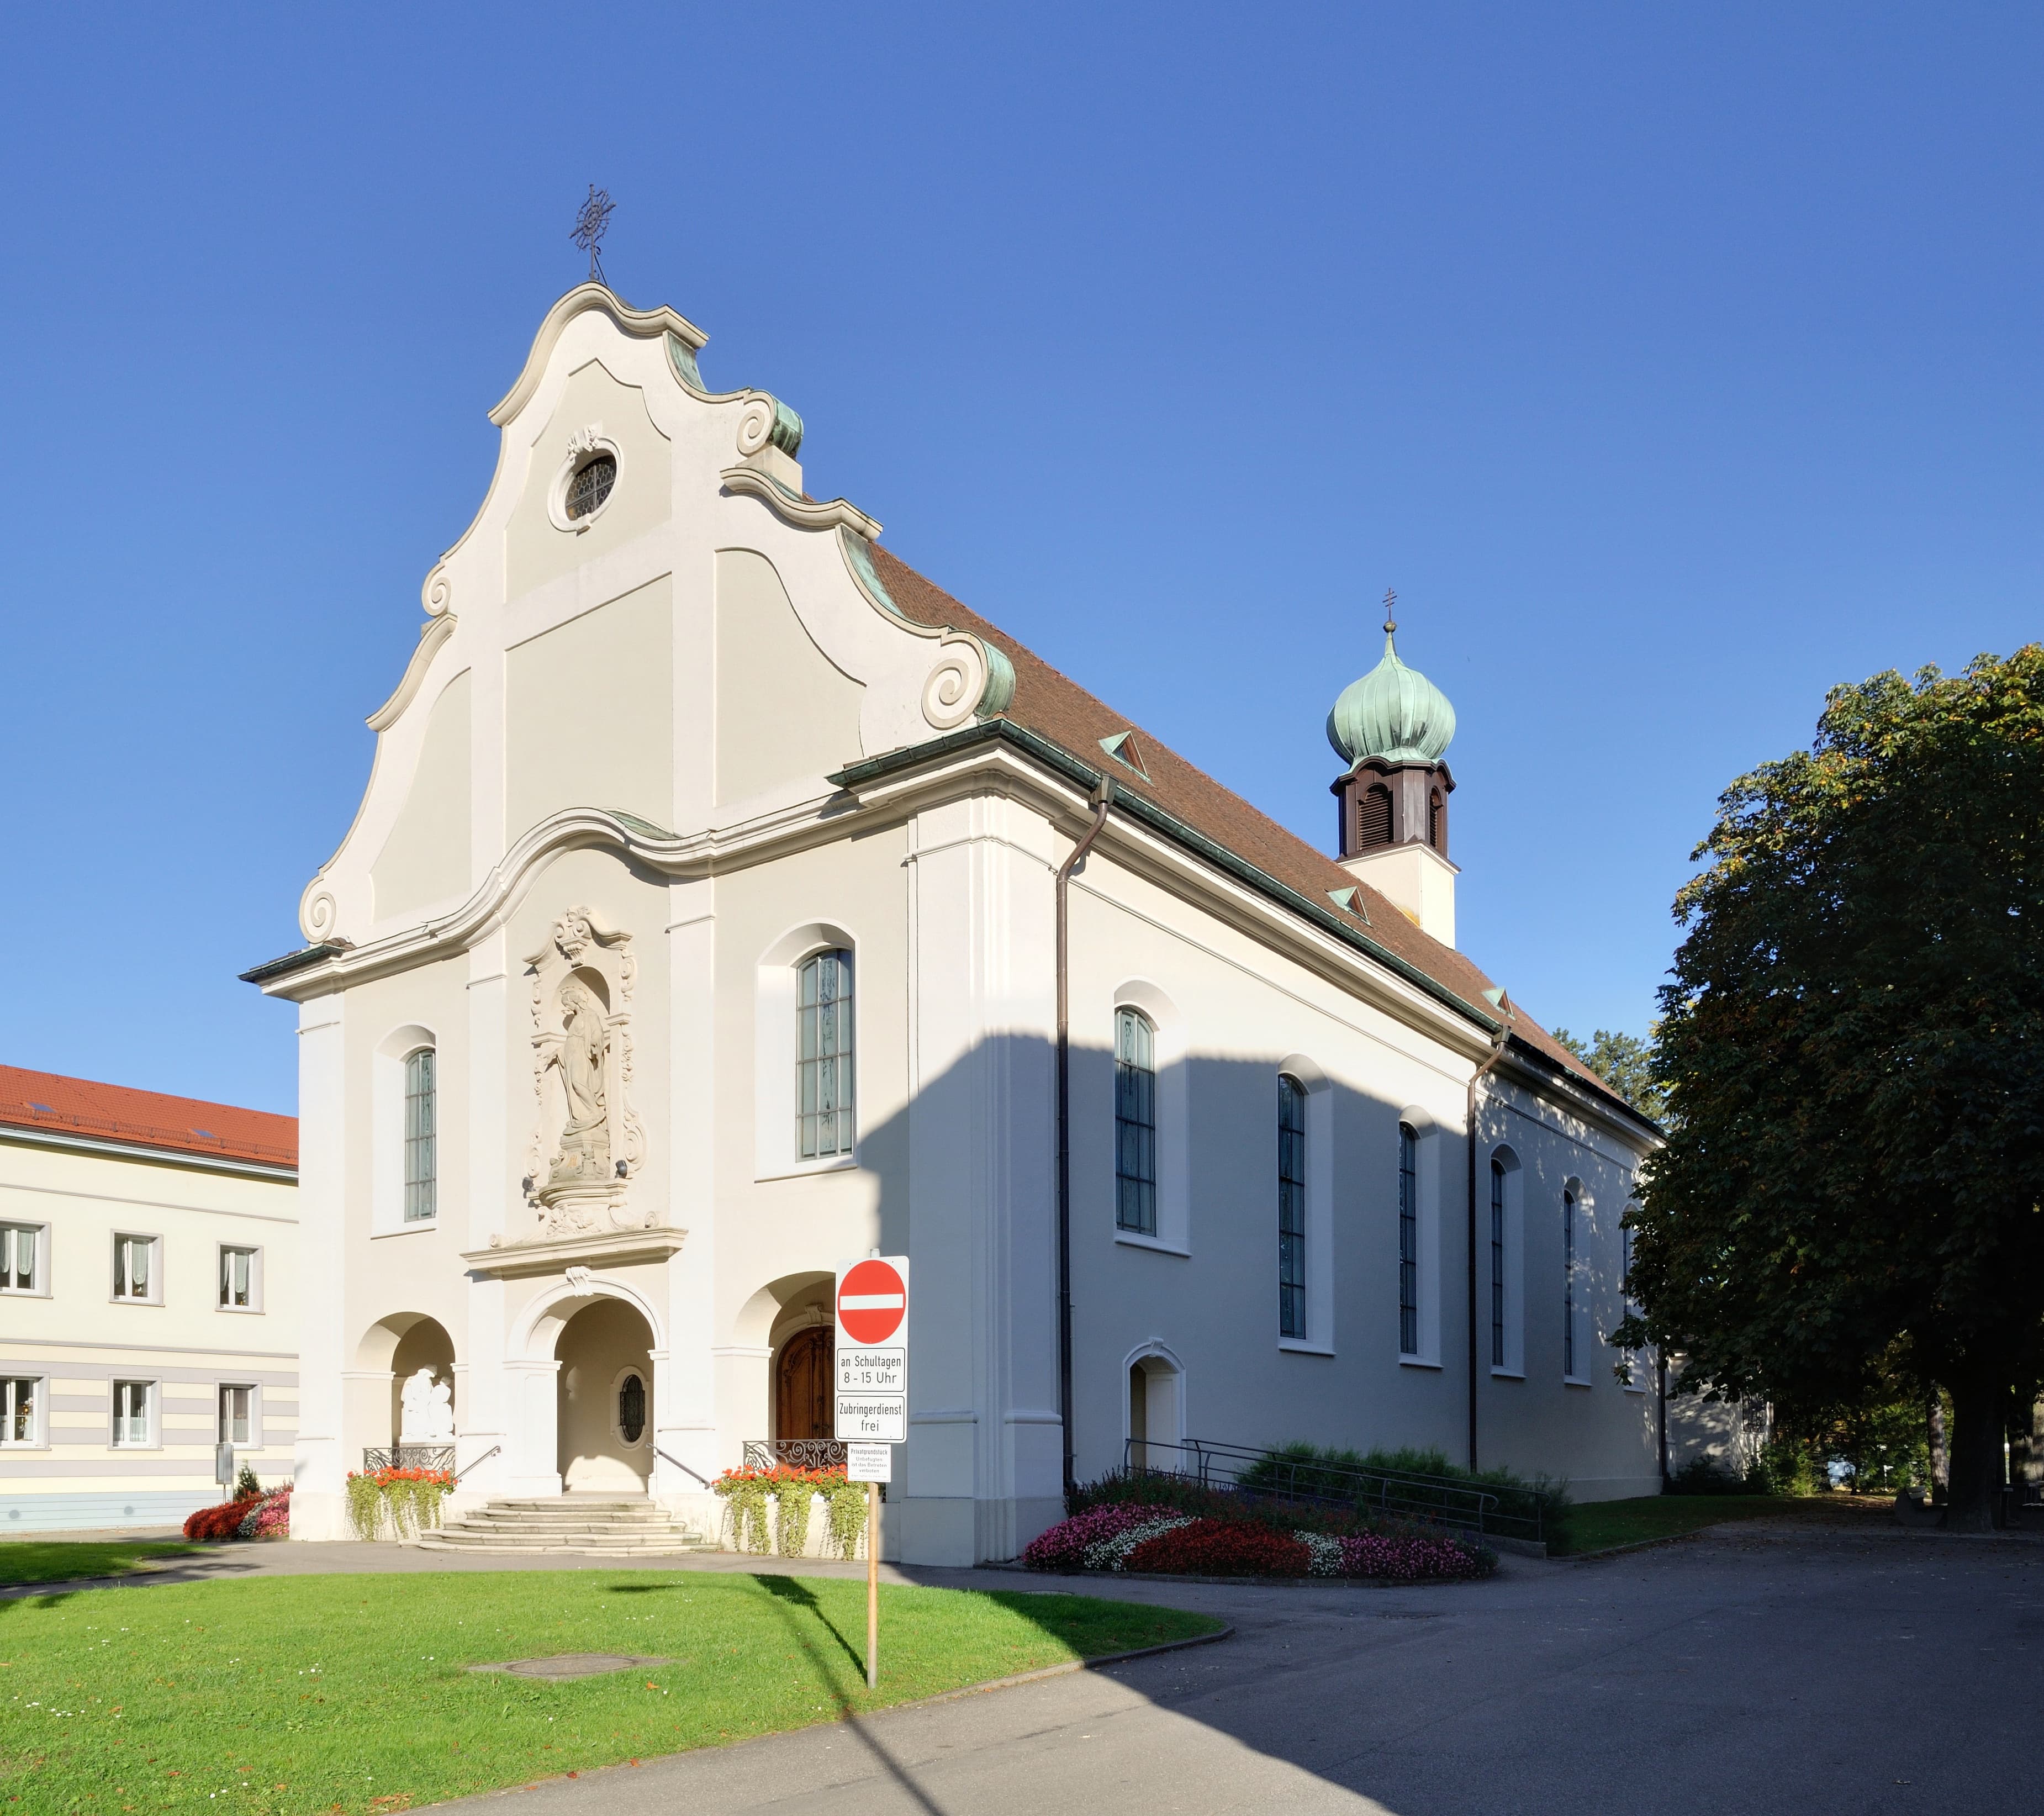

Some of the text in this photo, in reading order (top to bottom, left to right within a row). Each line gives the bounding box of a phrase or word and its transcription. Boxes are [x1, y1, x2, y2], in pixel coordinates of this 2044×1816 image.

[841, 1355, 901, 1370] an Schultagen
[844, 1372, 850, 1383] 8
[862, 1372, 872, 1383] 15
[876, 1372, 897, 1383] Uhr
[839, 1403, 902, 1417] Zubringerdienst
[861, 1419, 879, 1432] frei
